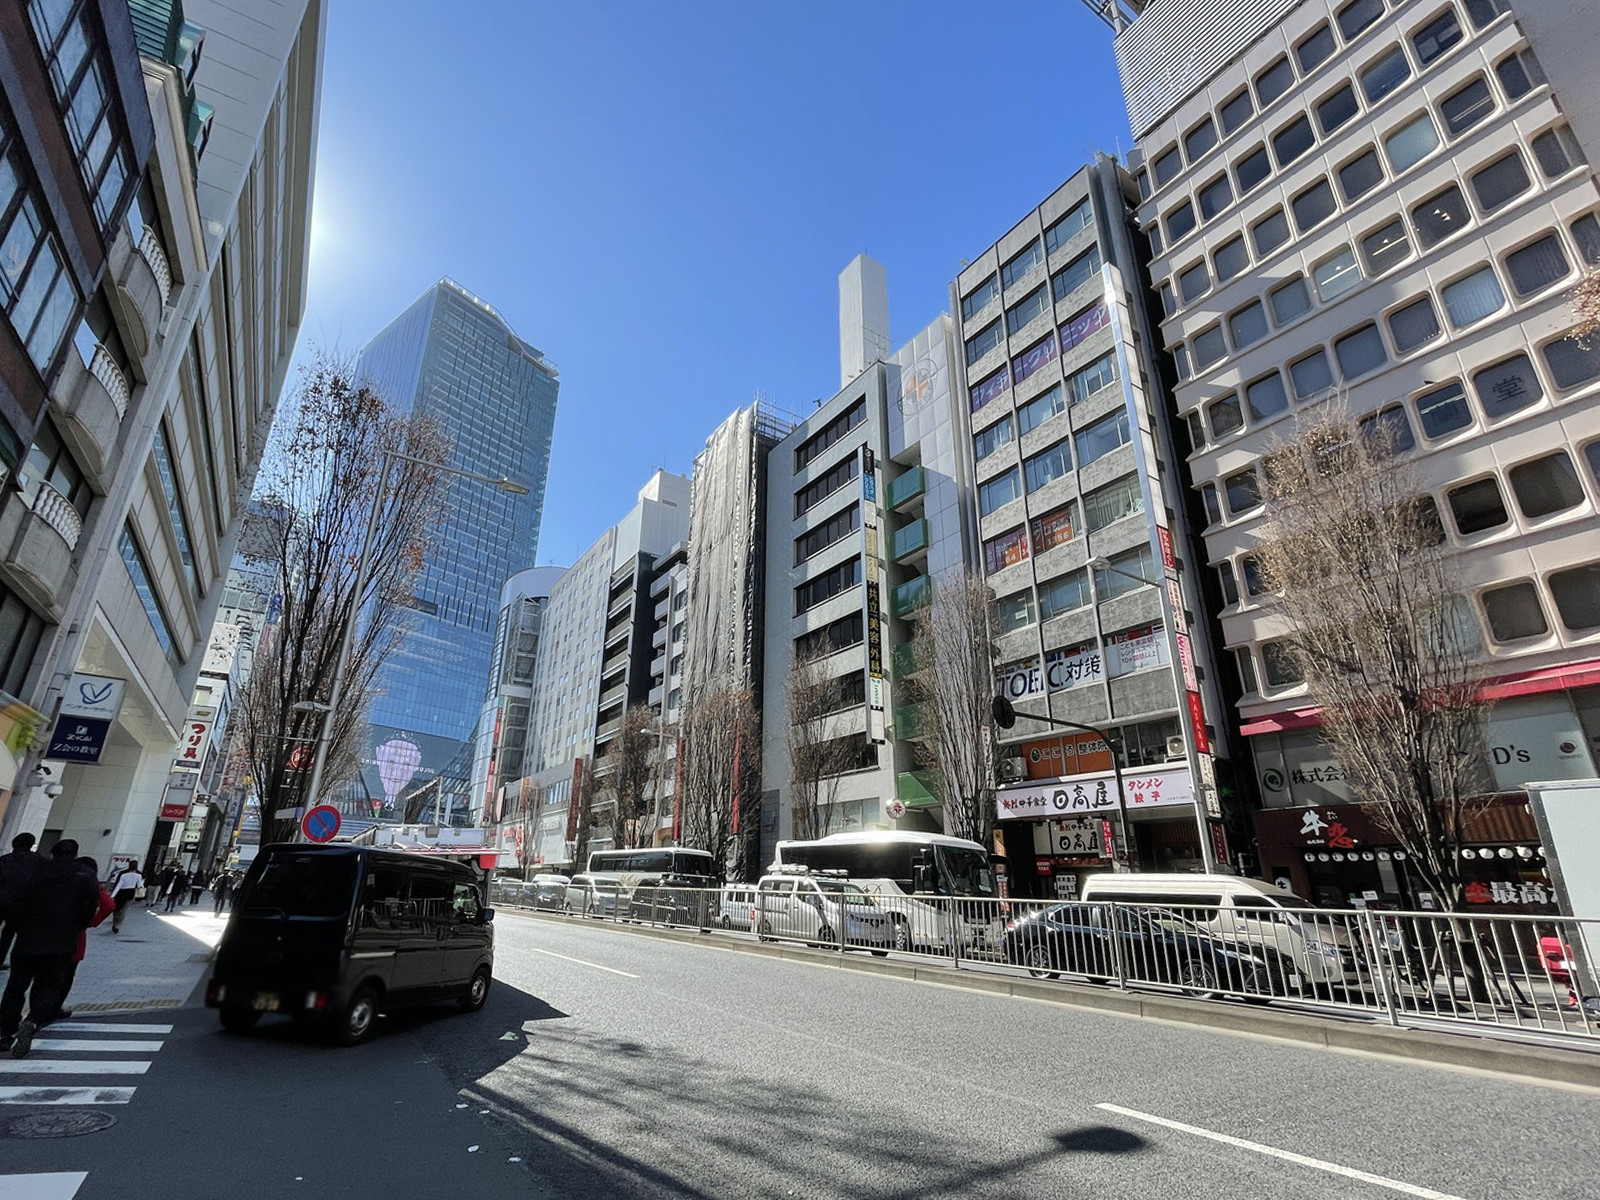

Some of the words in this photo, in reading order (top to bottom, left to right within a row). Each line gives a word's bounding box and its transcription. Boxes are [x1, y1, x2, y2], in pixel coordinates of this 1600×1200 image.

[1492, 375, 1527, 404] 堂
[868, 587, 881, 673] 共立美容外科
[1064, 655, 1102, 682] 対策
[53, 743, 99, 754] Z会の教室
[183, 723, 206, 759] つり具
[1492, 745, 1531, 765] D's
[1053, 780, 1114, 810] 日高屋
[1128, 777, 1163, 792] タンメン
[1059, 831, 1099, 851] 日高屋
